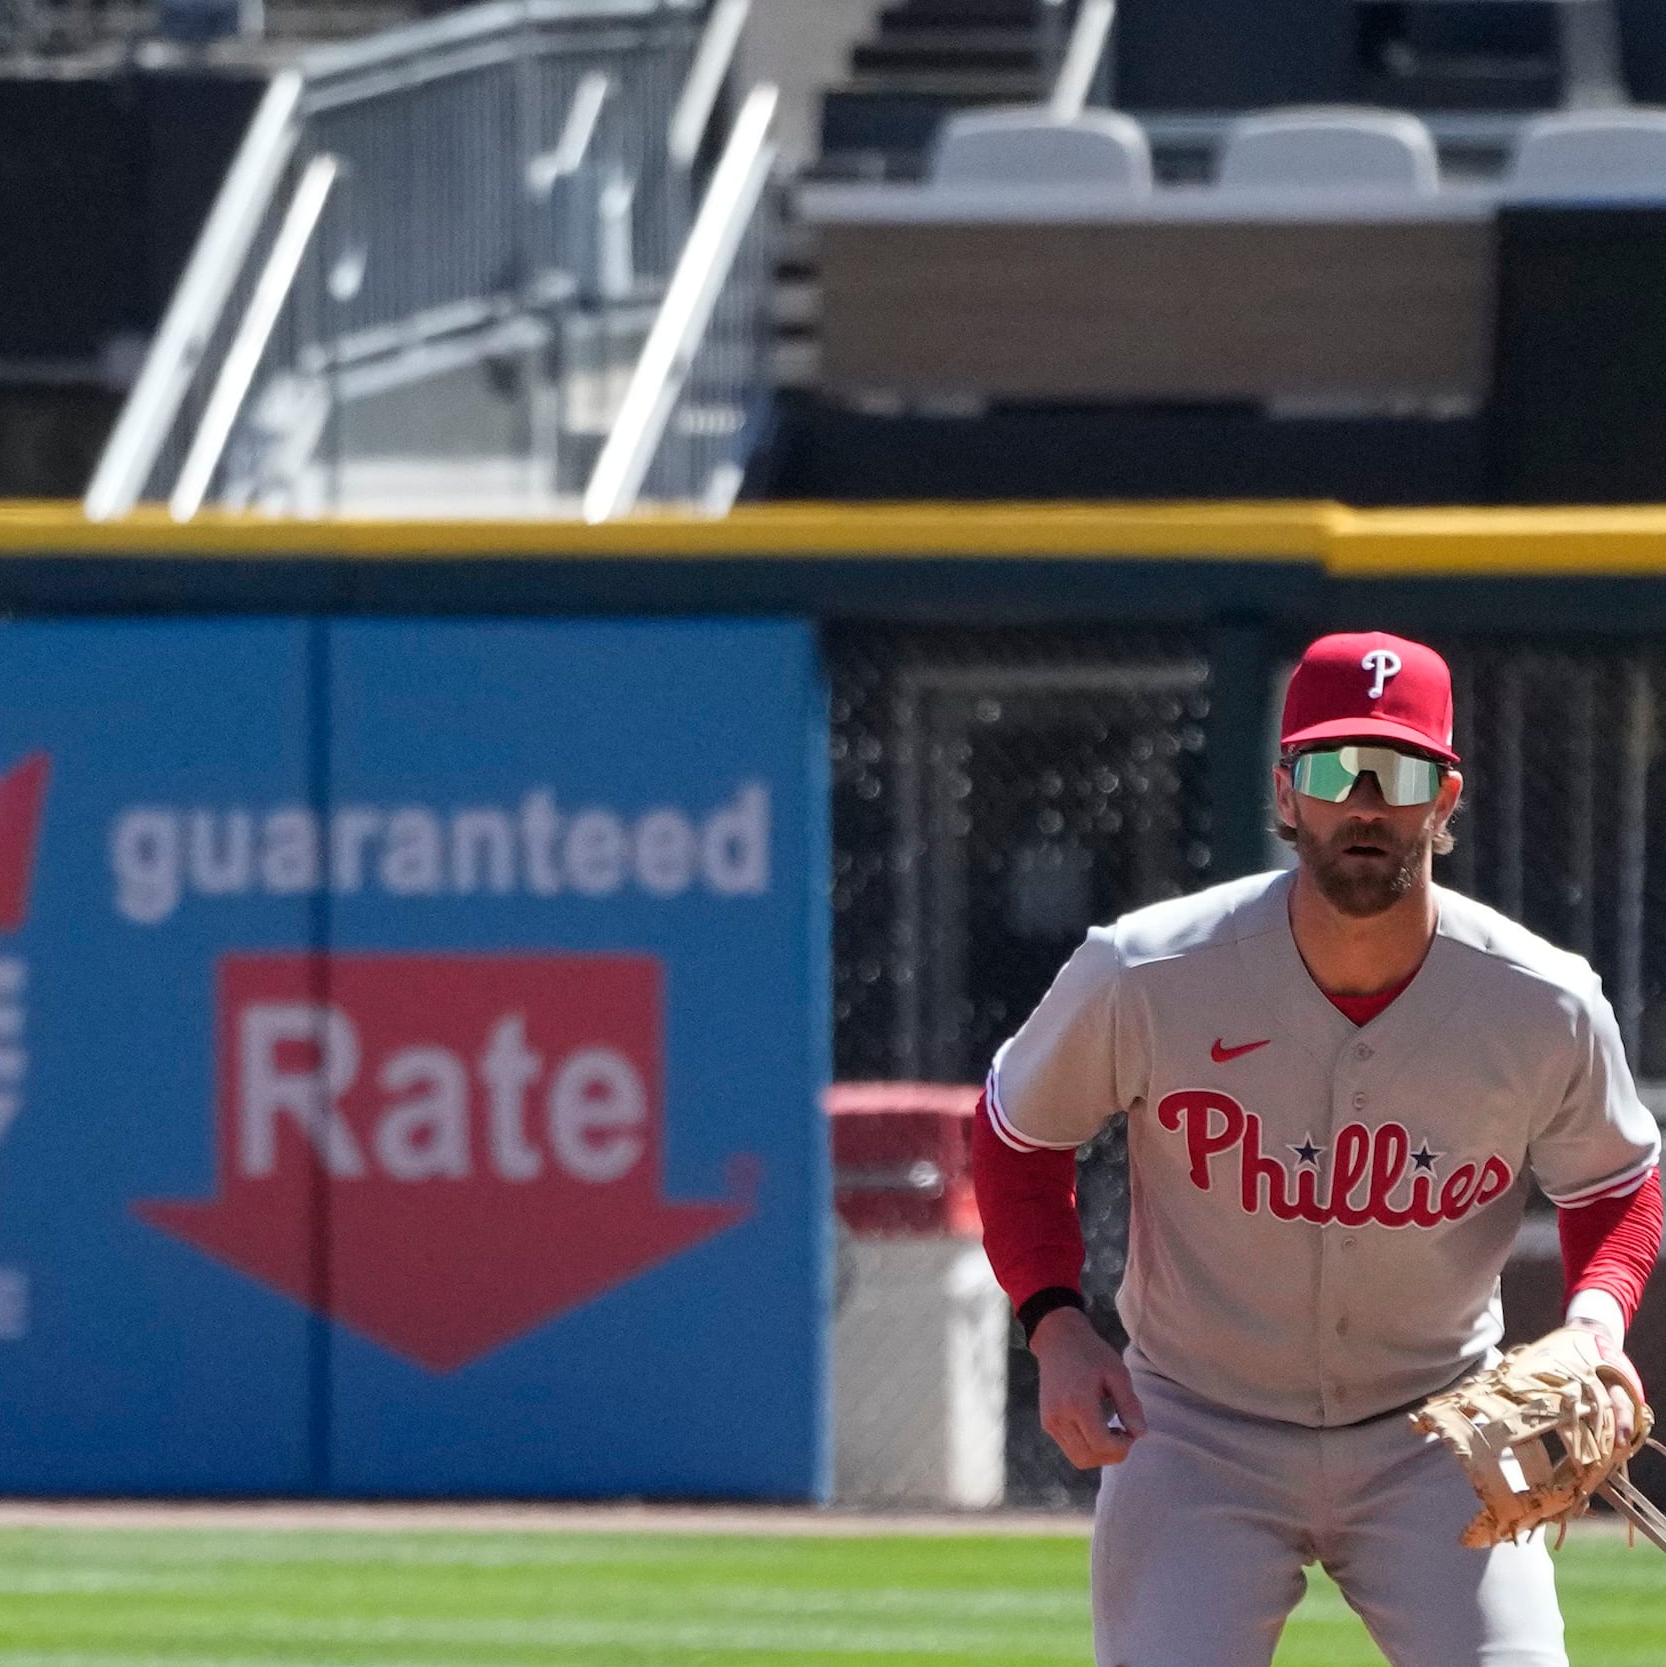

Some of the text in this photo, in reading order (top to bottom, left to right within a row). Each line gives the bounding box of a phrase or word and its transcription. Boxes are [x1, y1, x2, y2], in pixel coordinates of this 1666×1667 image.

[1361, 649, 1403, 699] P
[111, 780, 773, 923] guaranteed
[238, 1002, 647, 1183] Rate
[1157, 1088, 1514, 1230] Phillies
